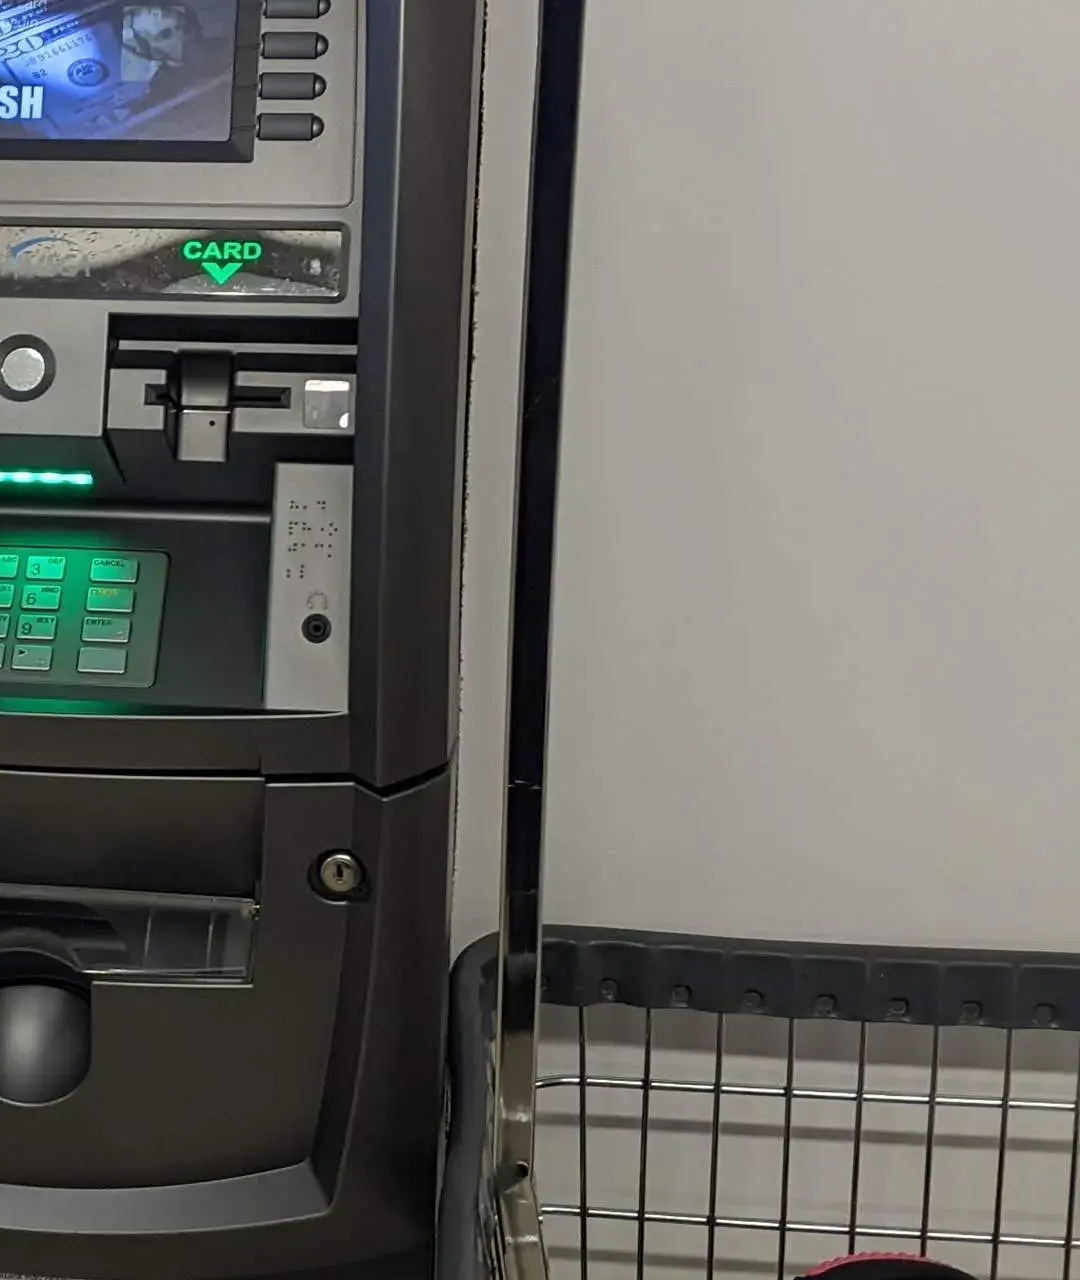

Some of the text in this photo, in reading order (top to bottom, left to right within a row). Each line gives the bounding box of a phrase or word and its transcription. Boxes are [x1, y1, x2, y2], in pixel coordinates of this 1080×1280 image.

[183, 241, 262, 260] CARD
[32, 563, 40, 575] 3
[26, 592, 37, 605] 6
[22, 623, 31, 635] 9
